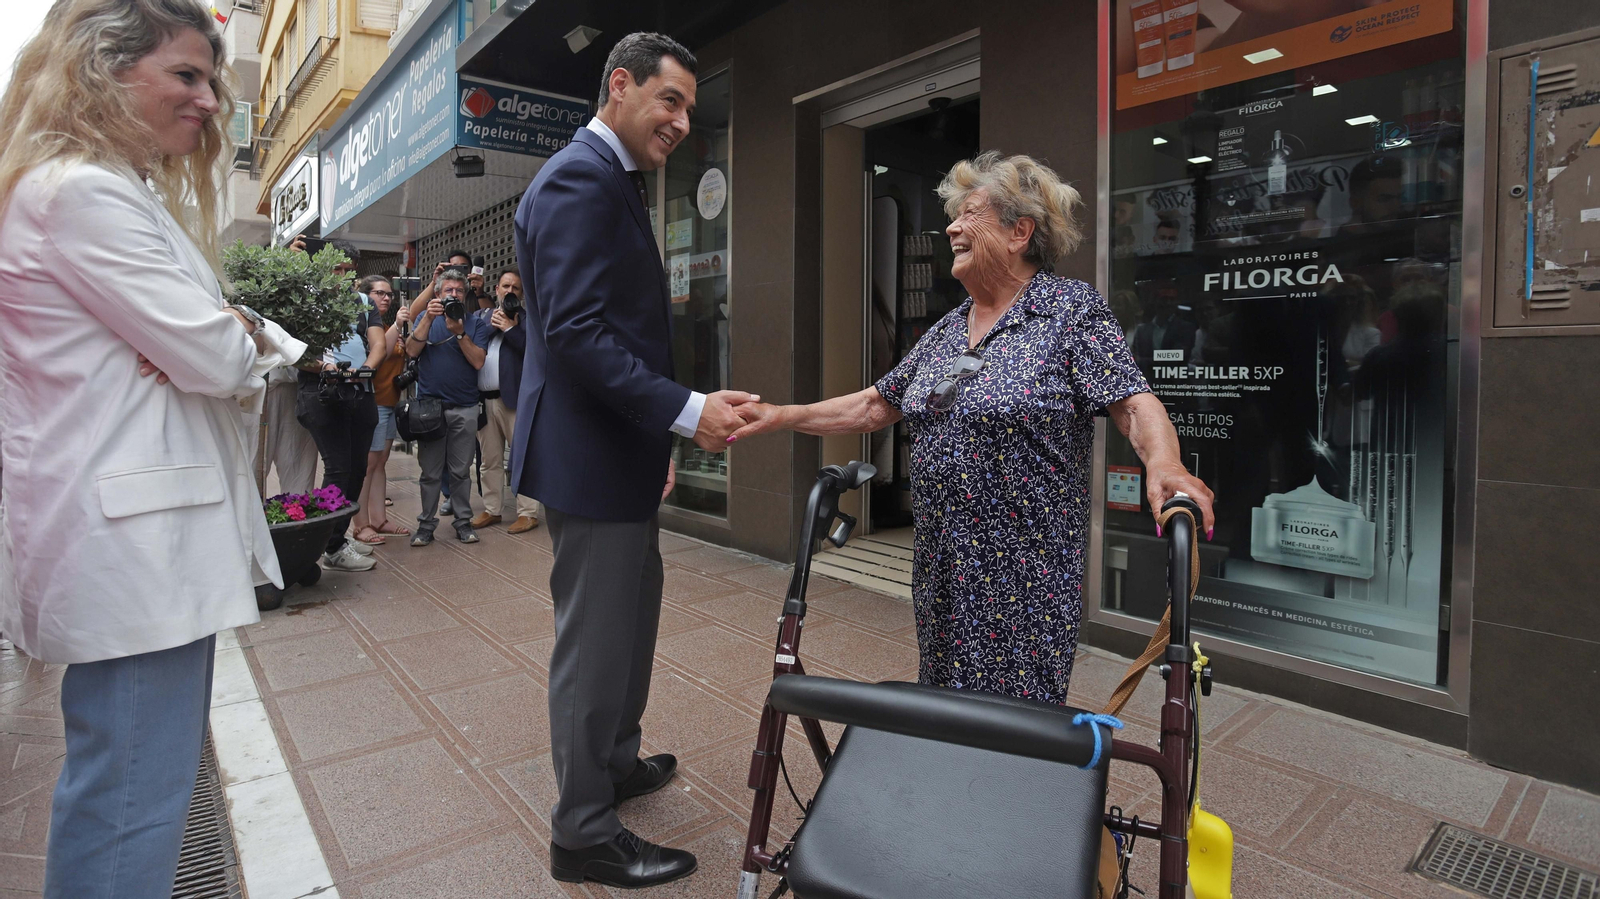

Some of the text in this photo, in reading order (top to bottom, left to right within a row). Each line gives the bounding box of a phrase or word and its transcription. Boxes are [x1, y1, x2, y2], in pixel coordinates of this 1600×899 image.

[1355, 21, 1384, 32] OCEAN
[1386, 11, 1420, 25] RESPECT
[1356, 4, 1420, 26] SKIN PROTECT
[409, 24, 452, 87] Papelería
[412, 66, 446, 116] Regalos
[497, 94, 586, 125] algetoner
[1238, 100, 1284, 116] FILORGA
[407, 104, 450, 147] www.algetoner.com
[496, 116, 526, 127] suministro
[526, 121, 548, 131] integral
[548, 126, 560, 134] para
[1218, 128, 1245, 138] REGALO
[339, 81, 408, 191] algetoner
[464, 120, 528, 142] Papelería
[536, 132, 571, 150] Regal
[1218, 138, 1242, 146] LIMPIADOR
[408, 127, 450, 168] info@algetoner.com
[479, 140, 526, 151] www.algetoner.com
[1218, 148, 1242, 157] ELÉCTRICO
[334, 196, 354, 222] suministro
[354, 179, 370, 210] integral
[369, 175, 382, 196] para
[386, 155, 406, 183] oficina
[1223, 251, 1319, 266] LABORATOIRES
[1203, 264, 1344, 292] FILORGA
[1152, 366, 1284, 380] TIME-FILLER 5XP
[1168, 412, 1234, 426] SA 5 TIPOS
[1177, 426, 1231, 440] RRUGAS.
[1281, 523, 1339, 539] FILORGA
[1290, 520, 1330, 528] LABORATOIRES
[1280, 540, 1320, 551] TIME-FILLER
[1280, 550, 1301, 558] Correction
[1194, 594, 1375, 636] ORATORIO FRANCÉS EN MEDICINA ESTÉTICA
